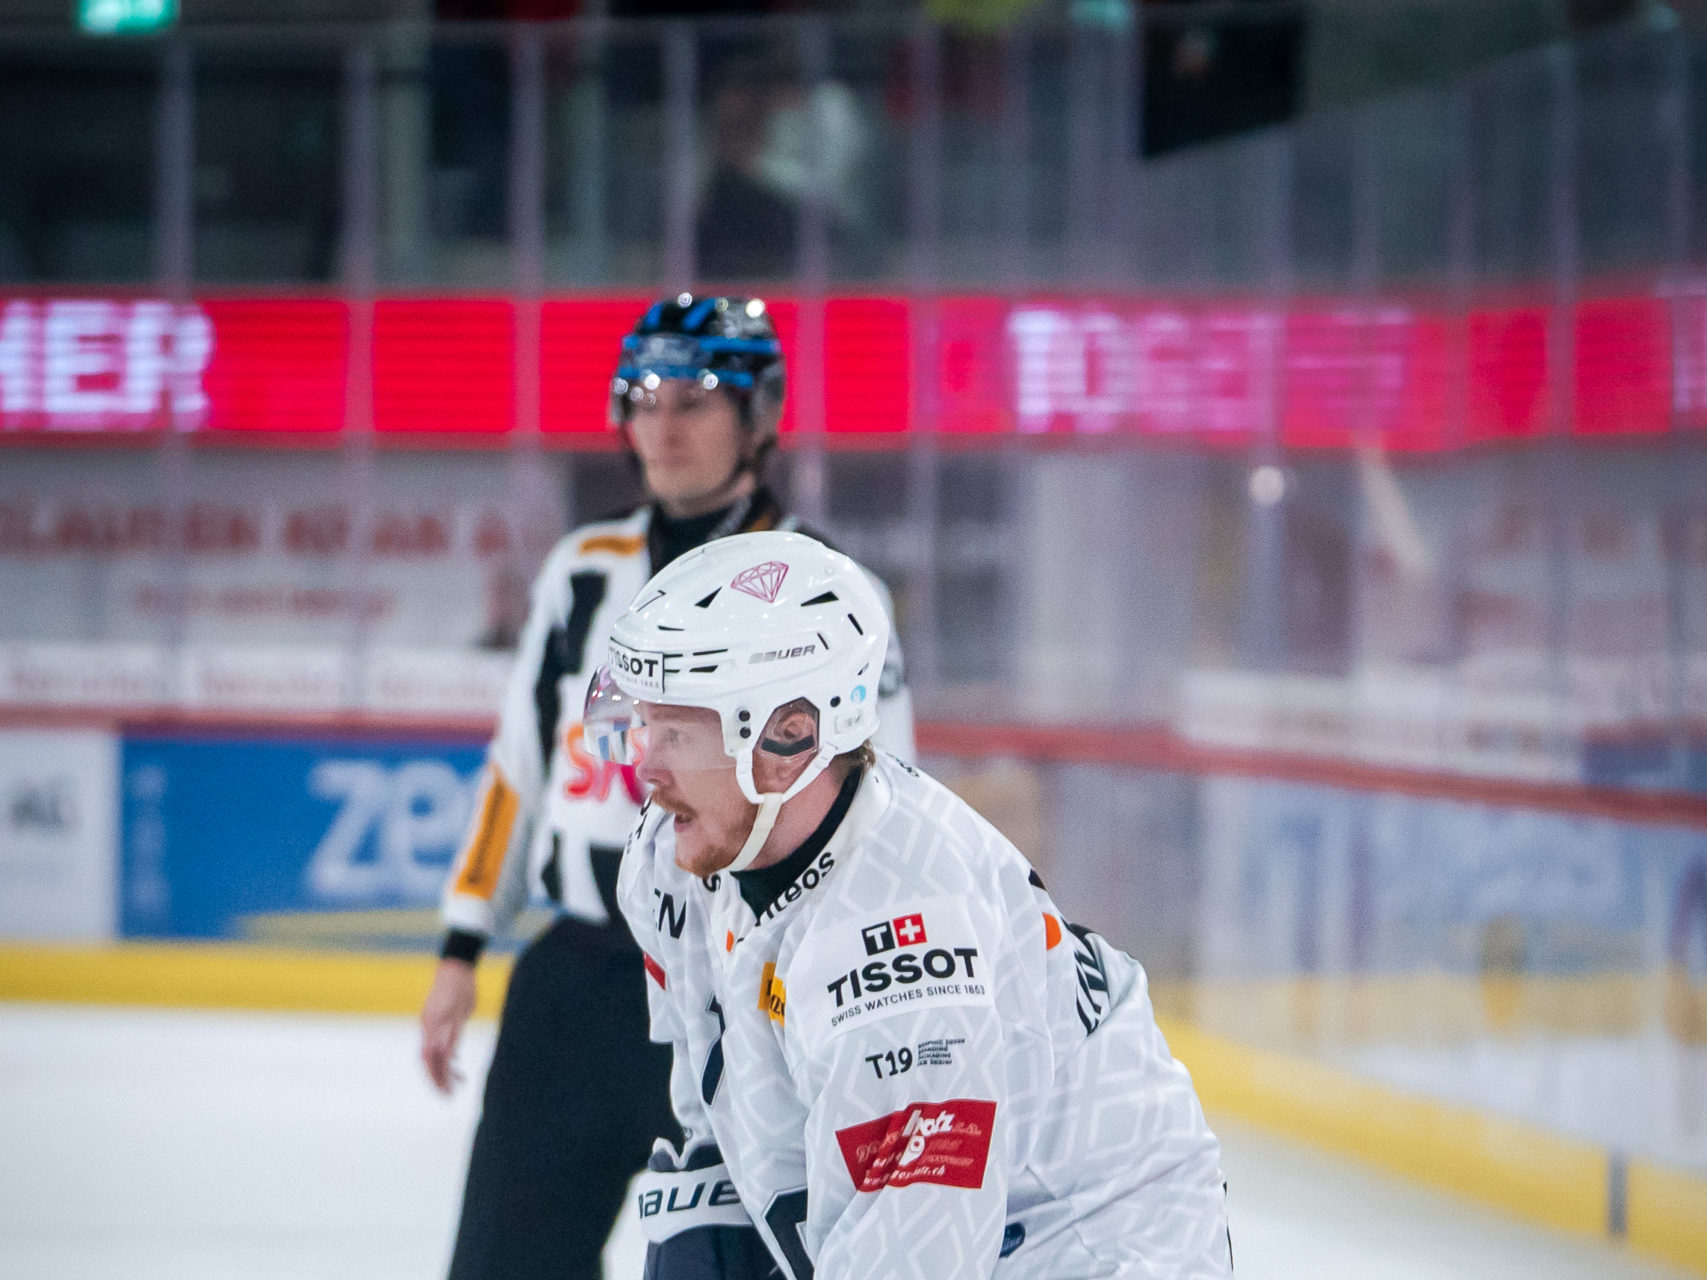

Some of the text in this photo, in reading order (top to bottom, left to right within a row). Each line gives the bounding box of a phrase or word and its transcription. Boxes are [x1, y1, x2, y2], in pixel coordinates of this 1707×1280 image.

[826, 947, 979, 1008] TISSOT
[831, 1004, 862, 1027] SWISS
[864, 988, 923, 1011] WATCHES
[926, 984, 962, 997] SINCE
[865, 1047, 913, 1079] T19
